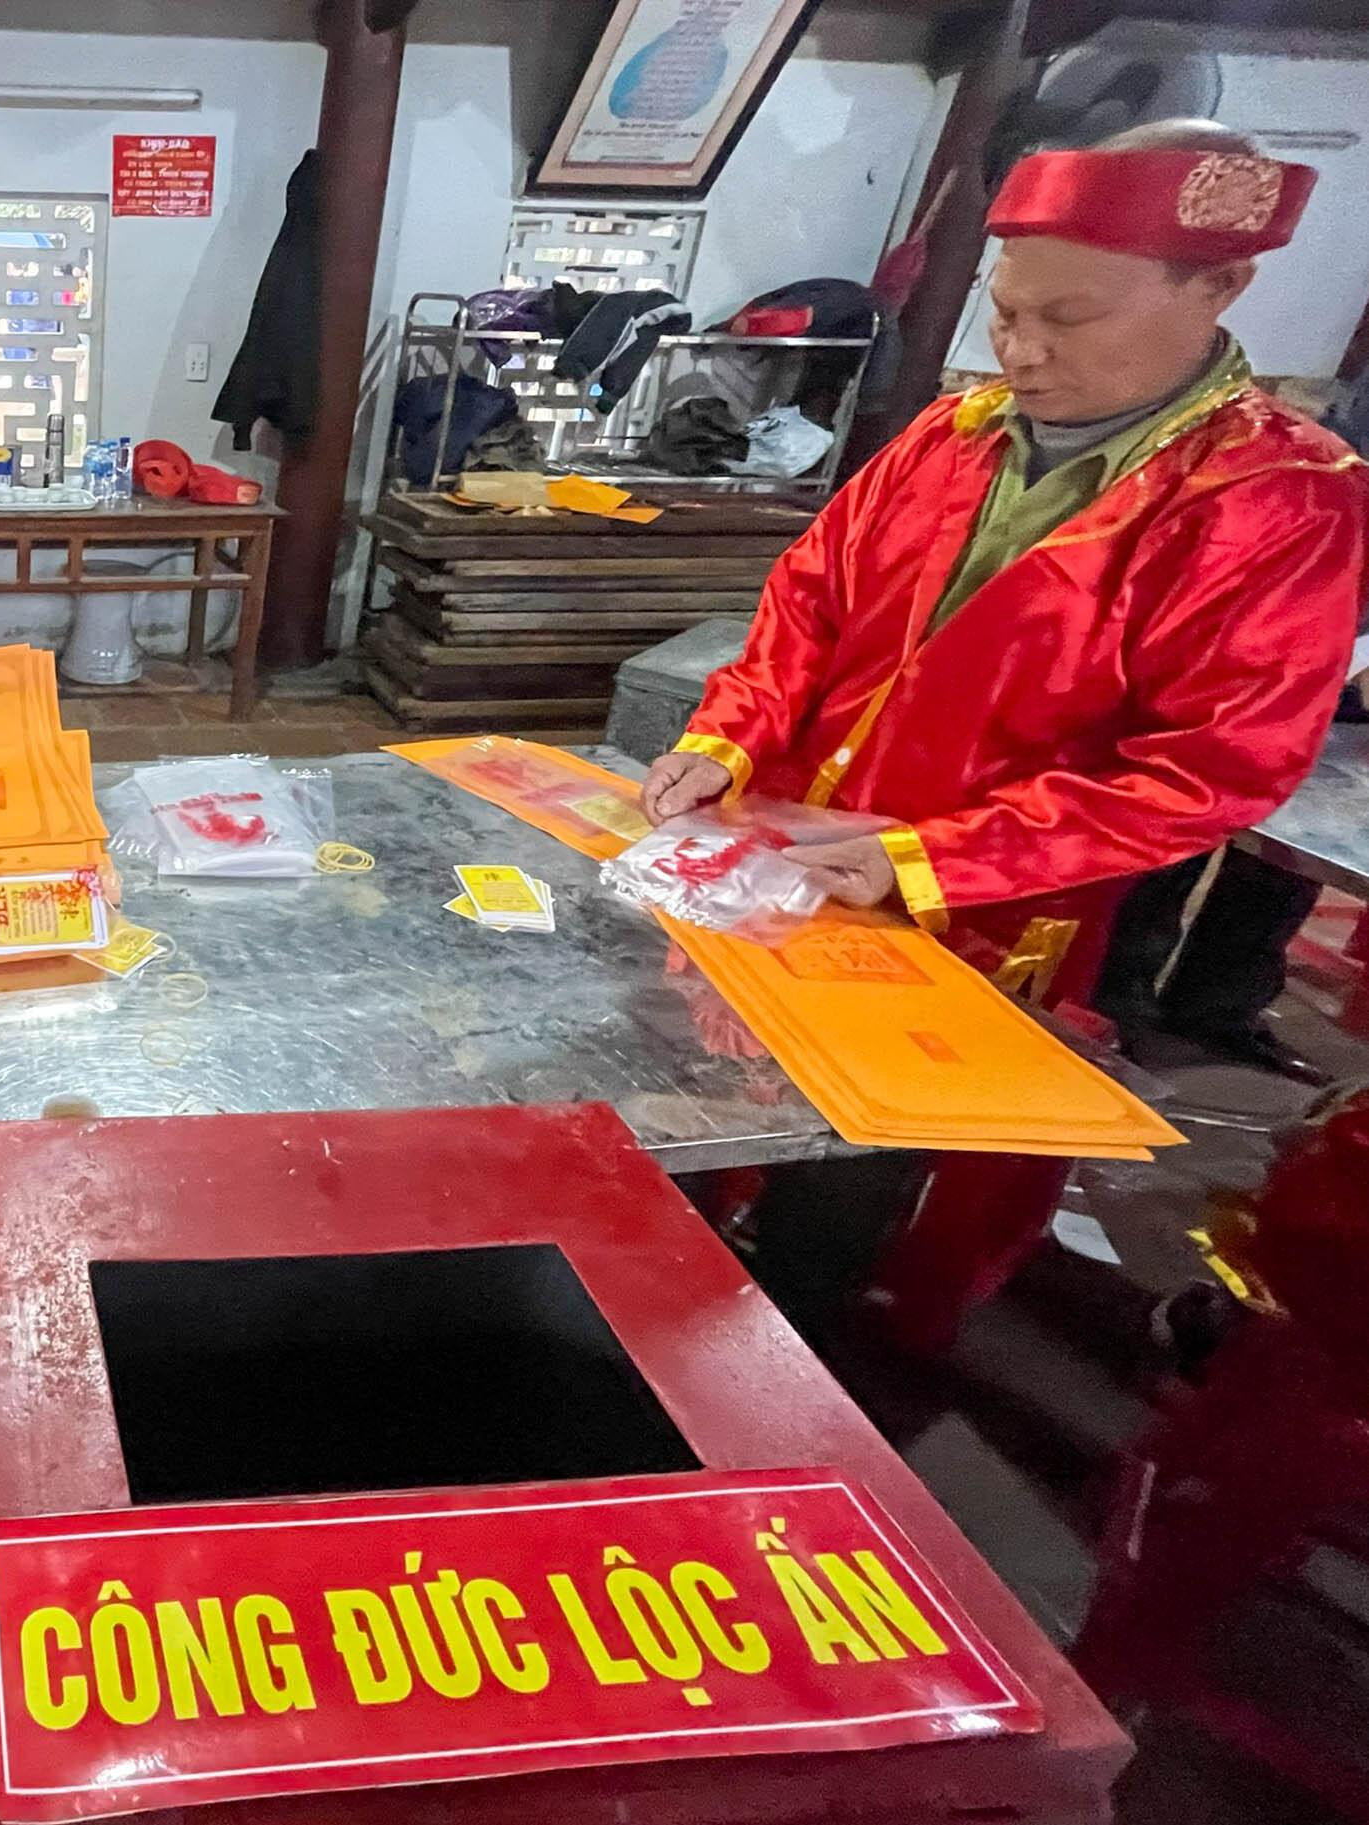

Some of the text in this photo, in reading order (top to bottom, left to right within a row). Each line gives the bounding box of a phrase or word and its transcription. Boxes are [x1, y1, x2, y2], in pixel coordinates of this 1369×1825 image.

[20, 1517, 948, 1730] CÔNG ĐỨC LỘC ẤN
